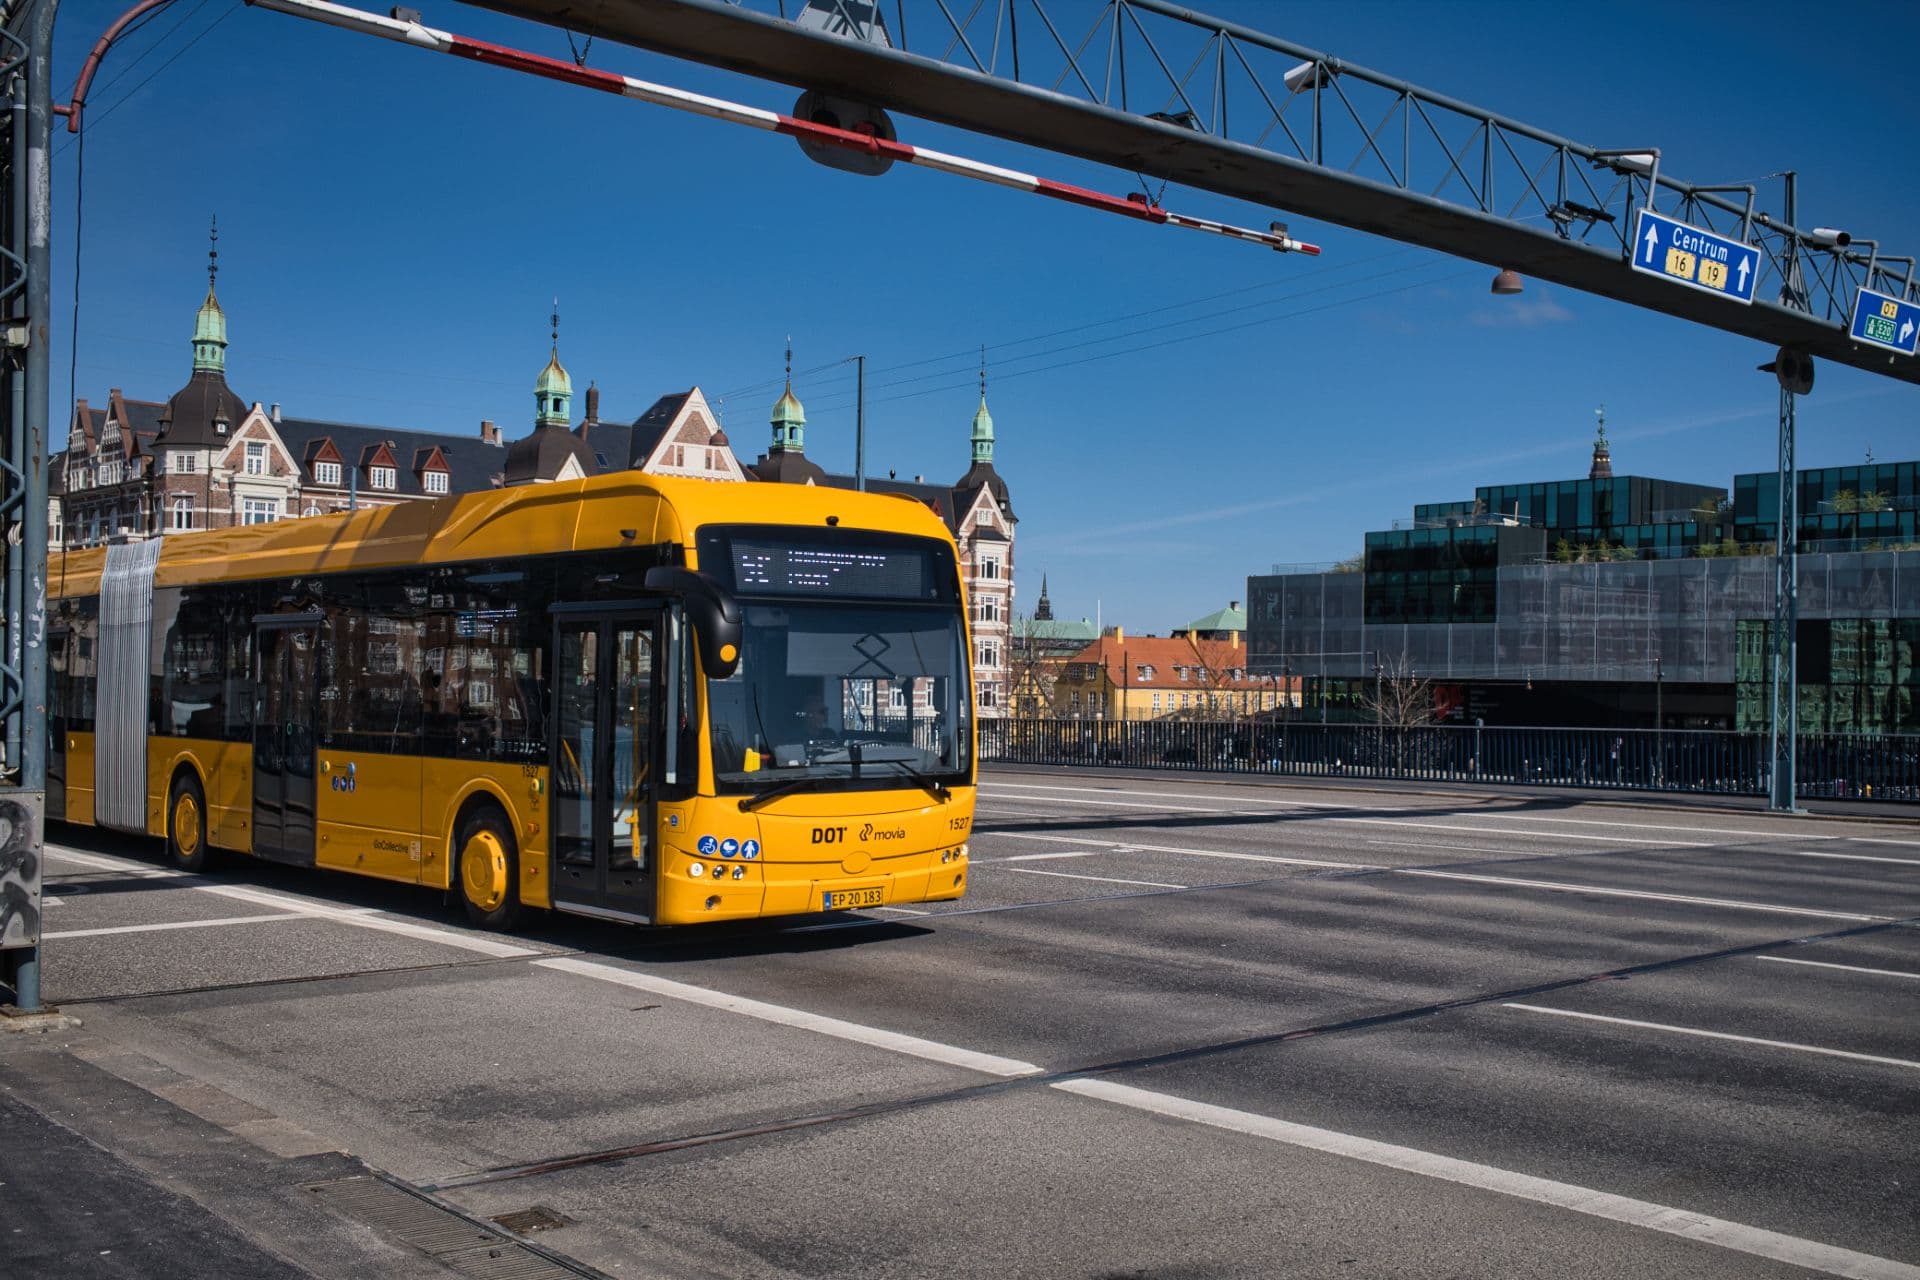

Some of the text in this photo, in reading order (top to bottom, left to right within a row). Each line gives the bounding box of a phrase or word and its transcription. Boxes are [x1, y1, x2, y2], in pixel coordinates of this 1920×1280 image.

[1672, 227, 1728, 262] Centrum
[1675, 255, 1687, 273] 16
[1707, 265, 1719, 282] 19
[1877, 323, 1892, 338] E20
[522, 765, 539, 778] 1527
[949, 816, 970, 831] 1527
[811, 827, 906, 845] DOT movia
[832, 889, 882, 907] EP 20 183
